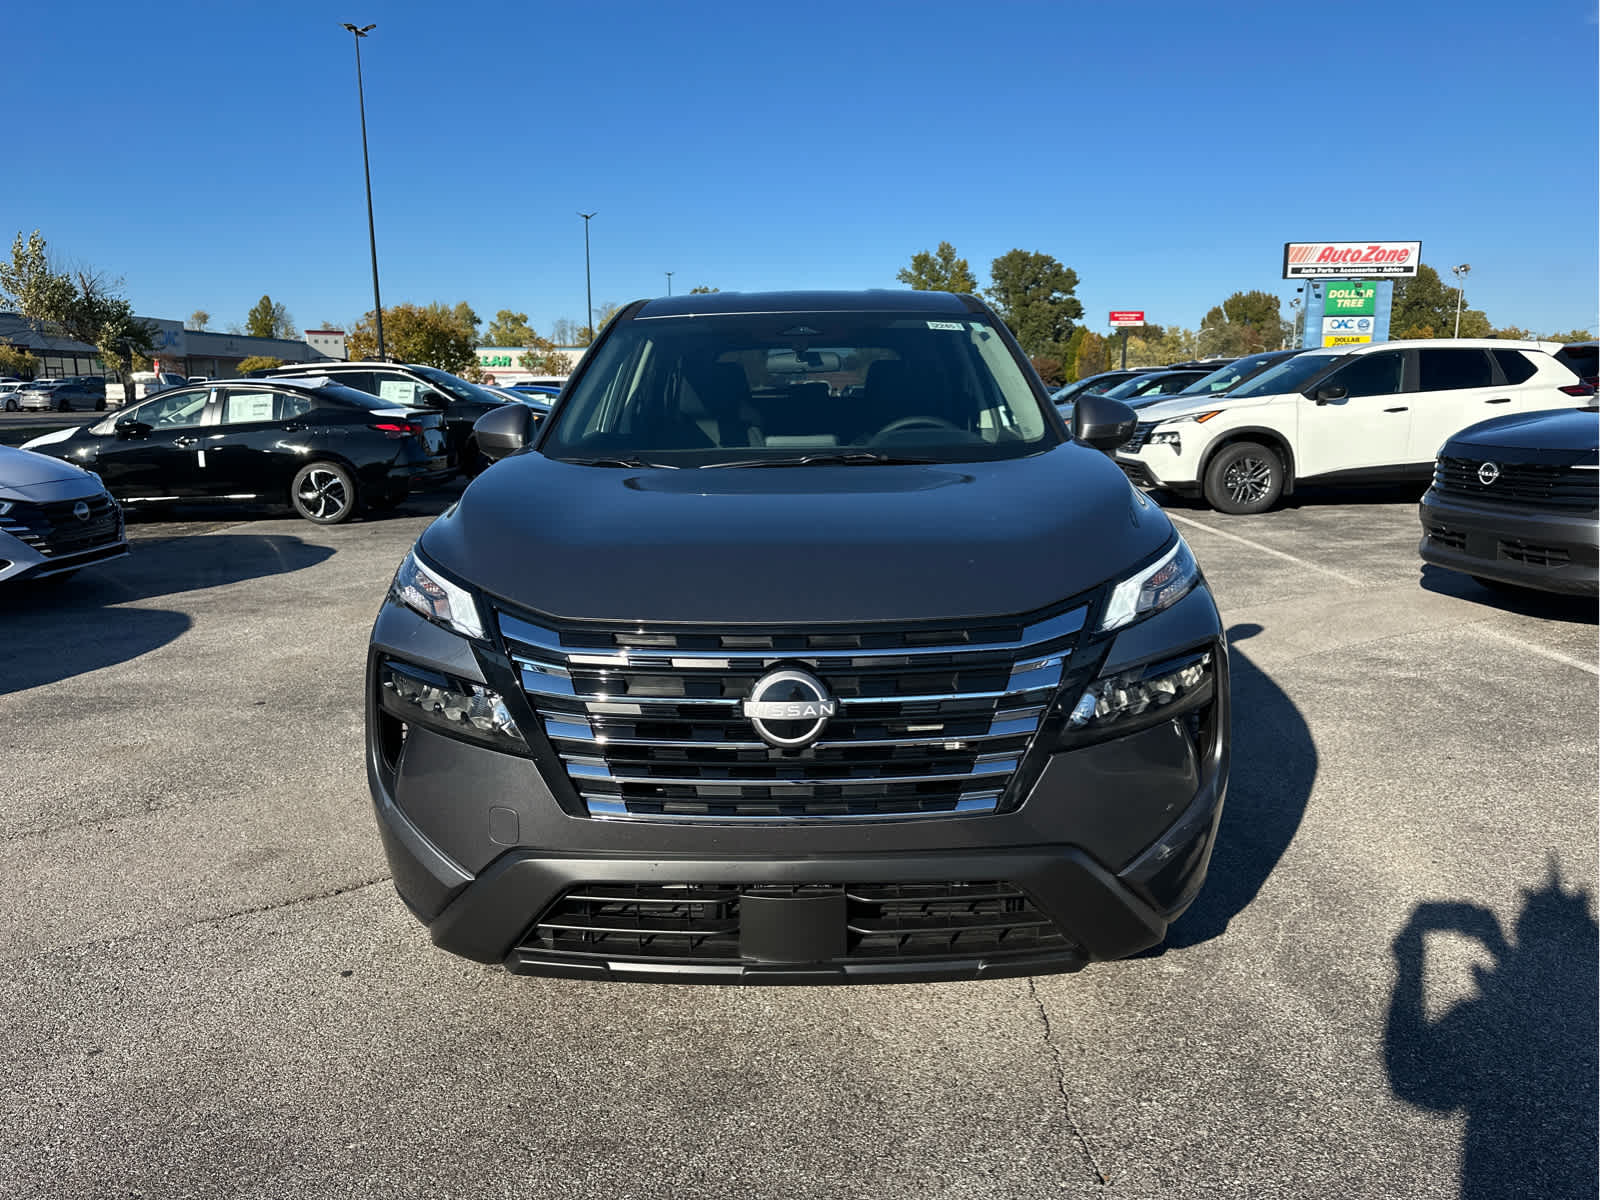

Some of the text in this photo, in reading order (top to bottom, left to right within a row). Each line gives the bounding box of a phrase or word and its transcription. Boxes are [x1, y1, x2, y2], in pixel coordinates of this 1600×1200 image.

[1317, 245, 1410, 262] AutoZone
[1328, 289, 1374, 298] DOLLAR
[1336, 299, 1365, 308] TREE
[745, 703, 834, 717] NISSAN
